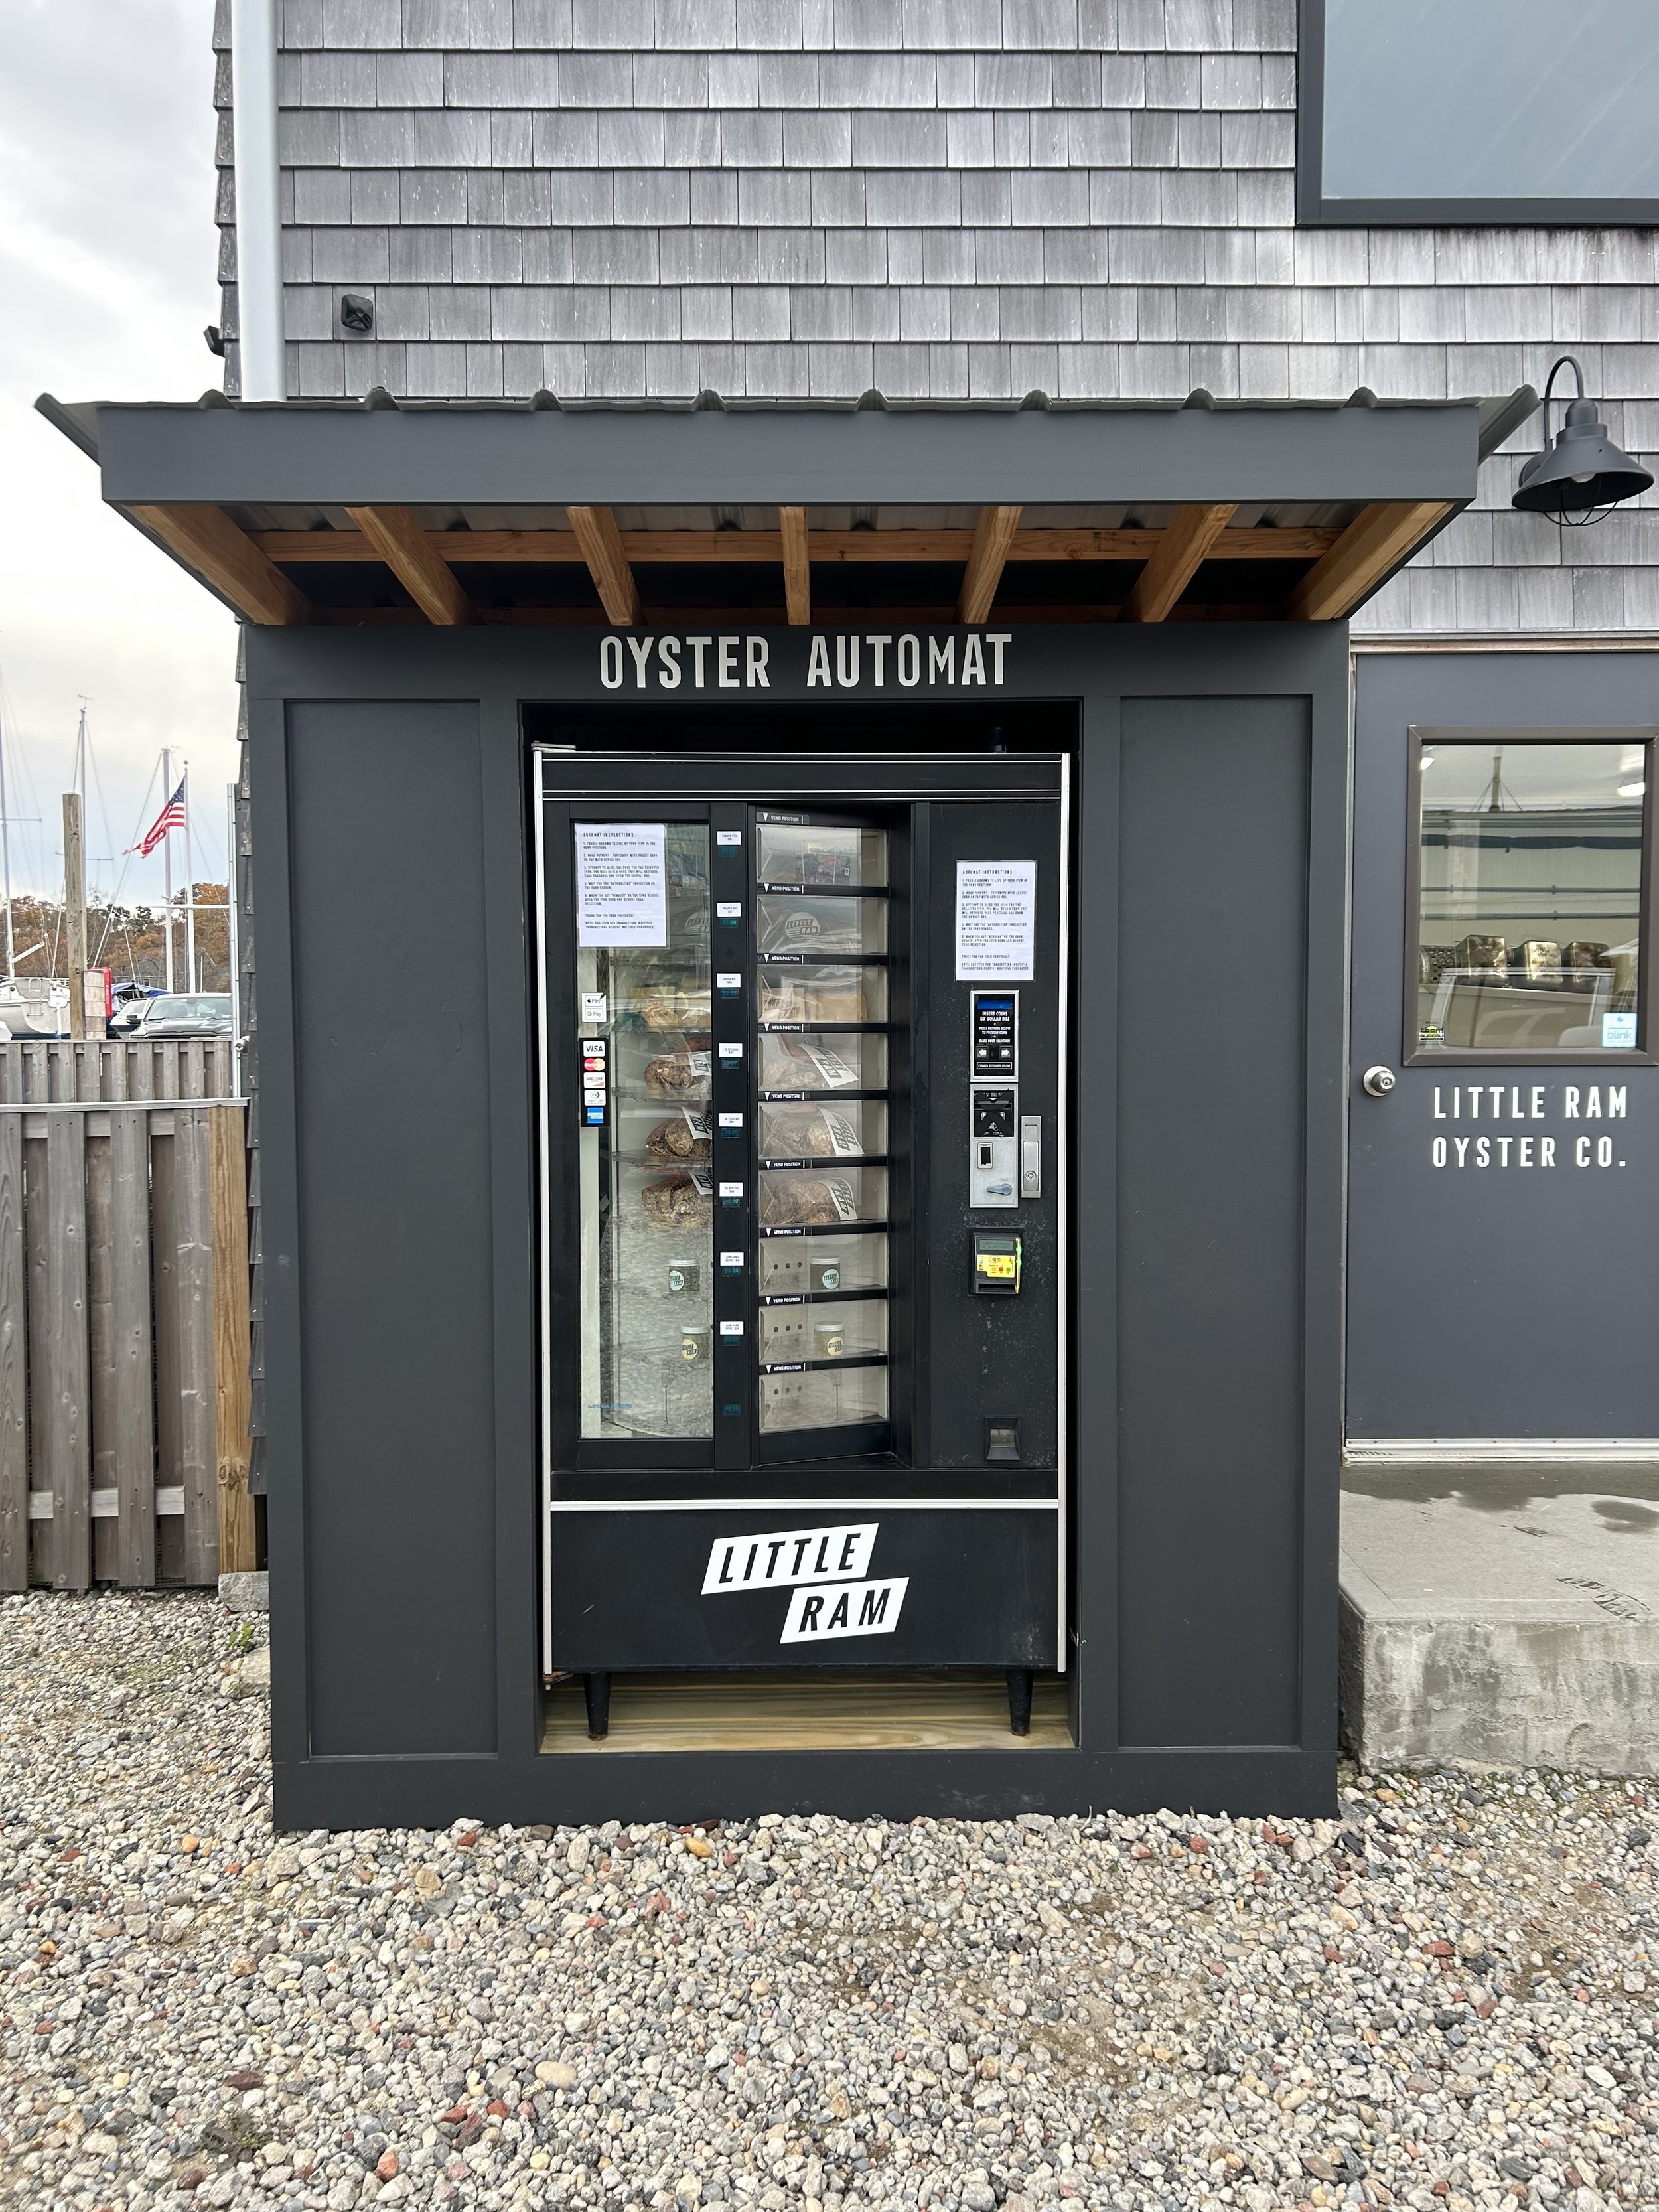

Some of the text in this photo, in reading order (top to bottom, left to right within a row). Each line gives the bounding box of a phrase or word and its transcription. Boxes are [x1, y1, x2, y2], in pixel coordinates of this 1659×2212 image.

[600, 634, 1012, 689] OYSTER AUTOMAT
[788, 919, 812, 928] LITTLE
[1607, 1030, 1632, 1039] blink
[820, 1059, 839, 1077] RAM
[1434, 1086, 1627, 1118] LITTLE RAM
[835, 1128, 848, 1149] RAM
[1433, 1136, 1626, 1168] OYSTER CO.
[835, 1189, 848, 1213] RAM
[719, 1532, 861, 1584] LITTLE
[798, 1587, 891, 1633] RAM
